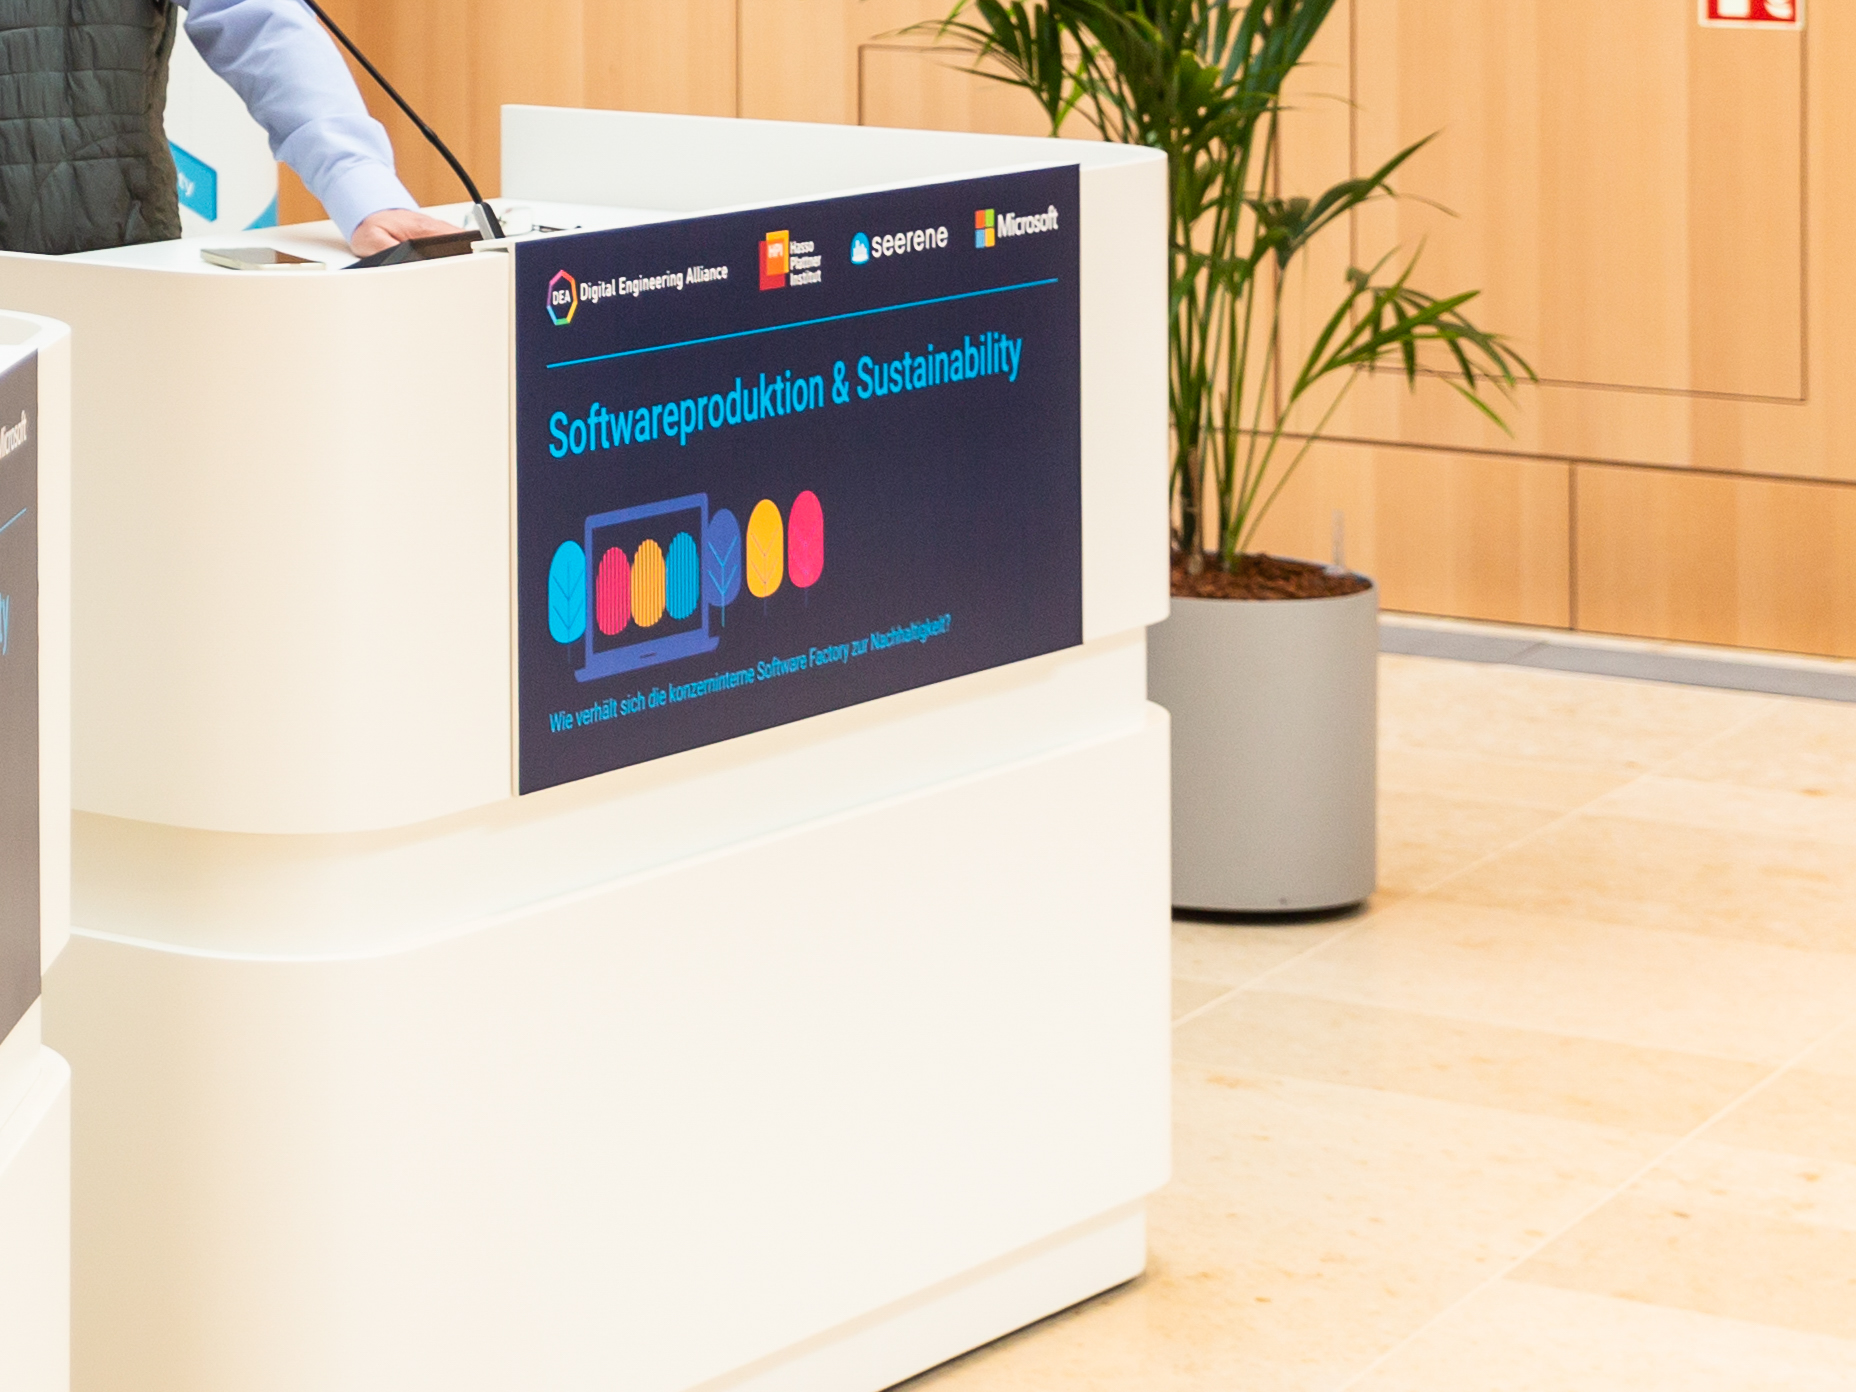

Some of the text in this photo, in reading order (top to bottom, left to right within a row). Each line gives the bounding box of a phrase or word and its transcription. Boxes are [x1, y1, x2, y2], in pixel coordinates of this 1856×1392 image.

[997, 205, 1059, 239] Microsoft
[871, 226, 949, 258] seerene
[552, 290, 571, 305] DEA
[580, 265, 729, 303] Digital Engineering Alliance
[548, 330, 1023, 459] Softwareproduktion & Sustainability
[549, 711, 574, 733] Wie
[648, 687, 667, 709] die
[756, 656, 807, 681] Software
[808, 643, 850, 668] Factory
